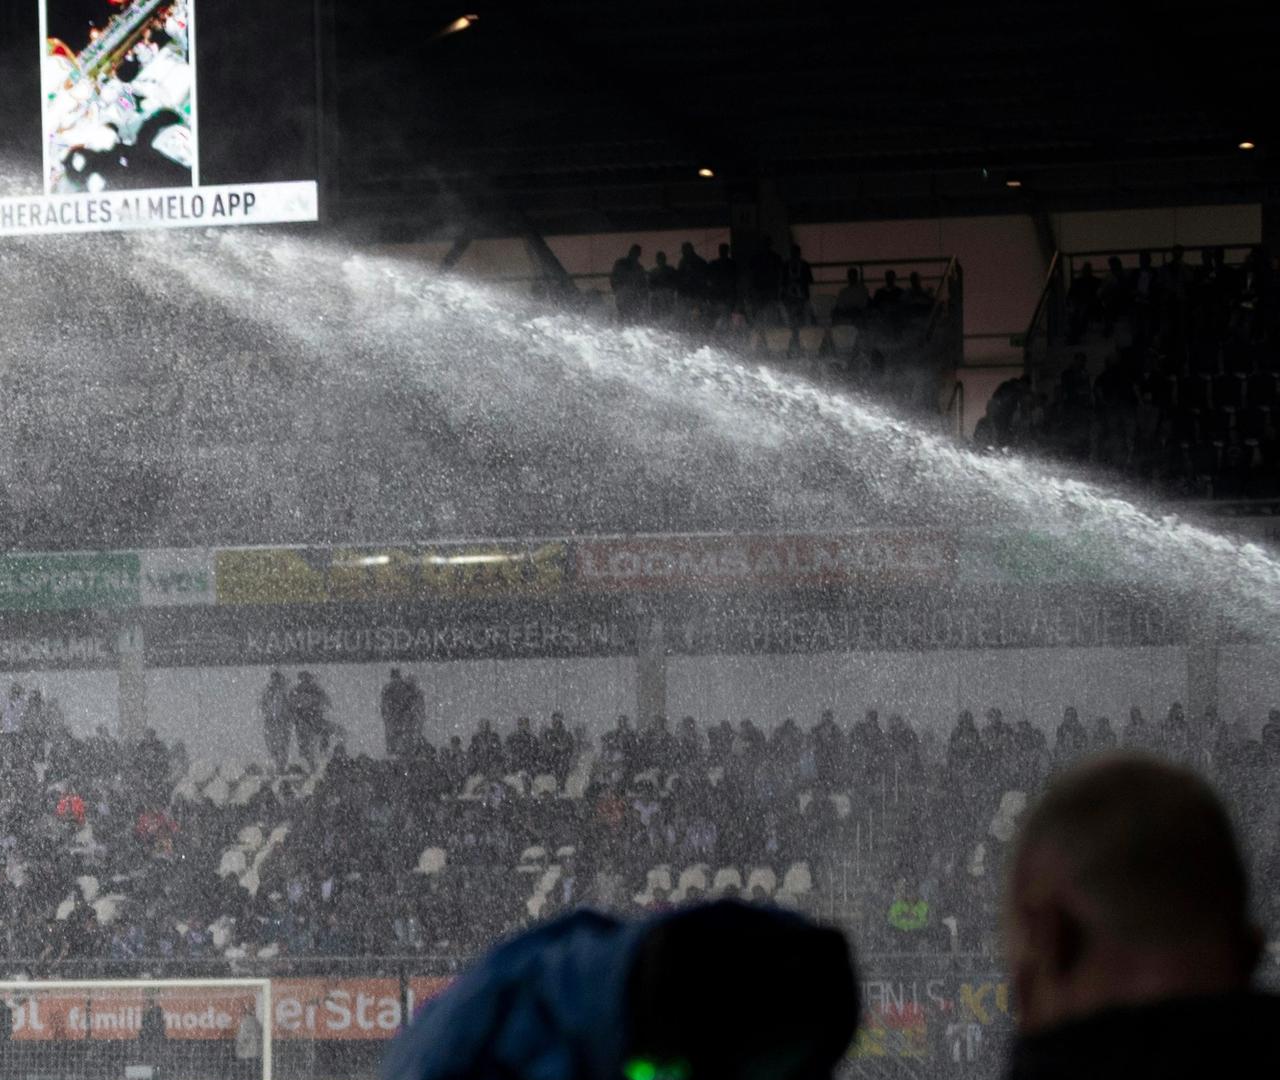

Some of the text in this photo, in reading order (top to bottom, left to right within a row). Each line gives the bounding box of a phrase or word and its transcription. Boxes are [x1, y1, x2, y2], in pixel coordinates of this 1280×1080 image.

[0, 198, 113, 229] HERACLES
[118, 194, 205, 224] ALMELO
[211, 191, 257, 218] APP
[67, 1004, 233, 1031] familimode
